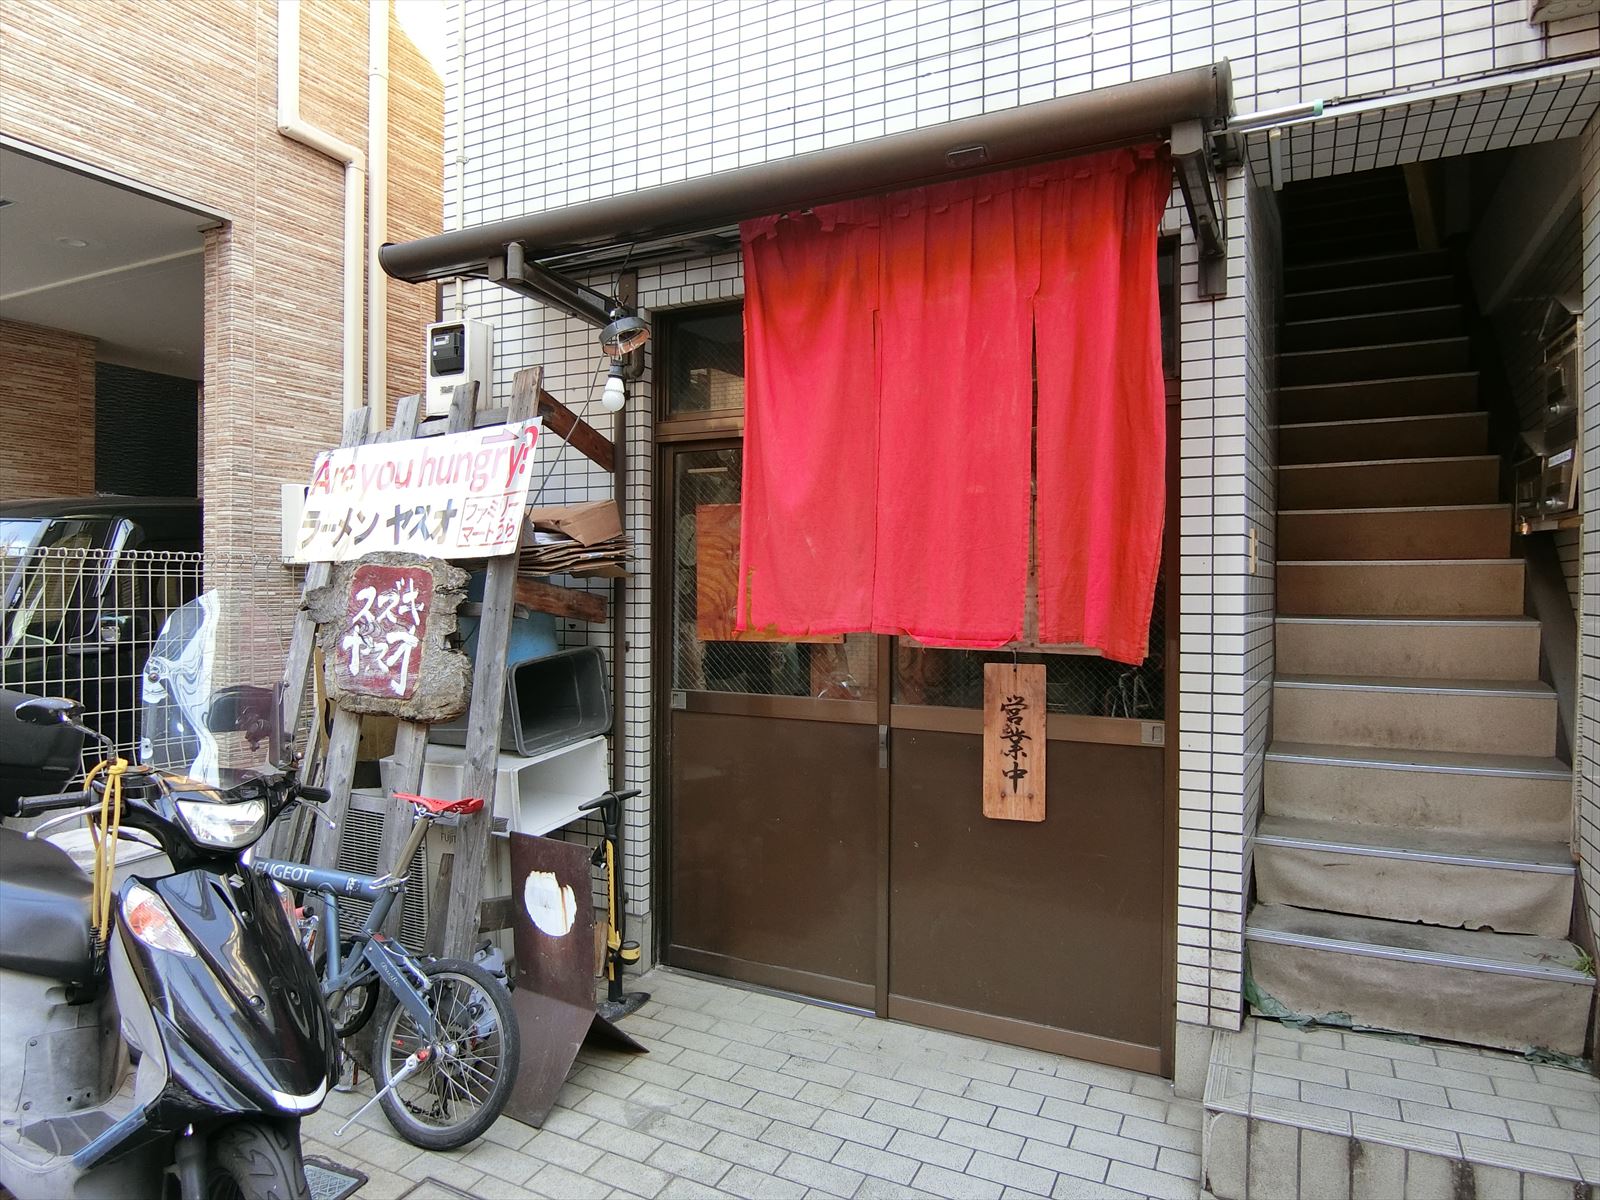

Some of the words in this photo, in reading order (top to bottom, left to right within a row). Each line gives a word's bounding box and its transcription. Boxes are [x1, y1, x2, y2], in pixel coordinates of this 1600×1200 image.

[310, 459, 356, 496] Are
[360, 458, 414, 500] you
[418, 425, 539, 493] hungry?
[302, 507, 379, 549] ラーメン
[465, 496, 519, 524] ファミリー
[352, 577, 425, 626] スズキ
[1000, 694, 1032, 794] 営業中
